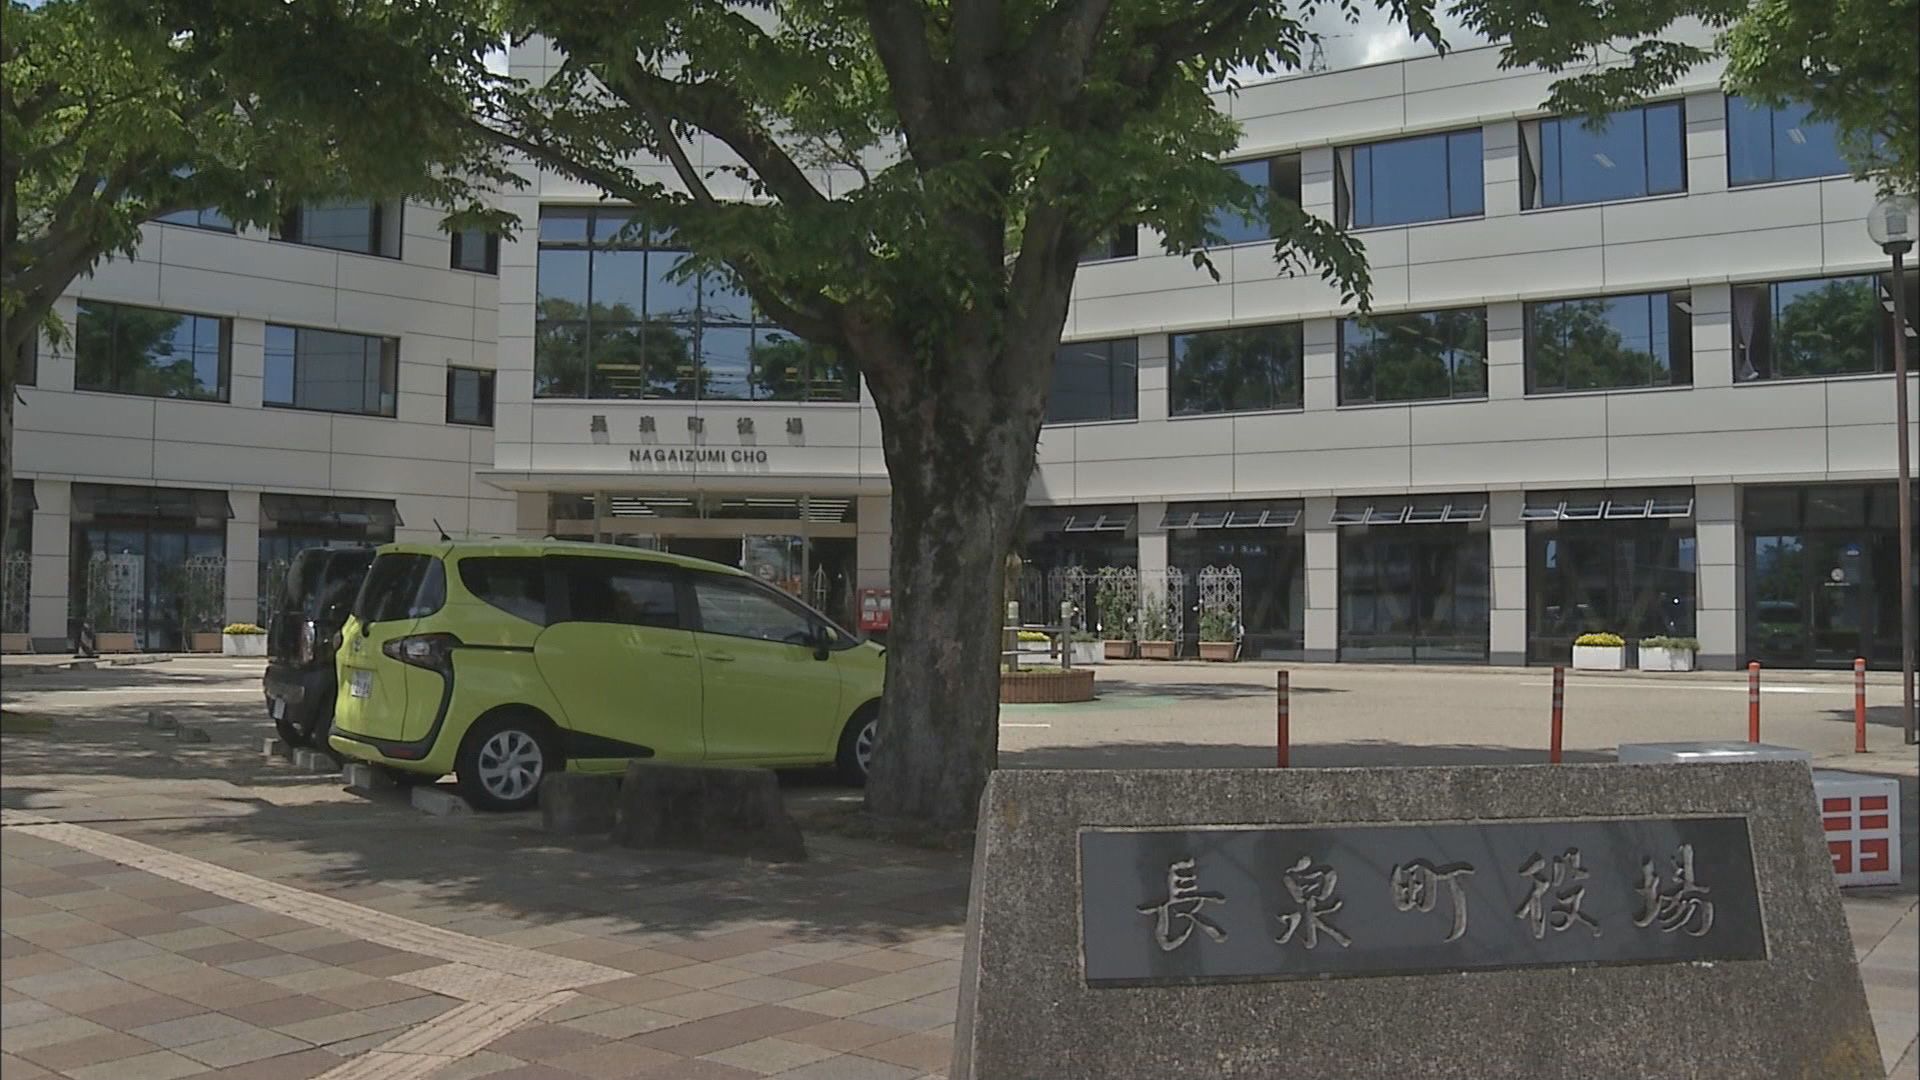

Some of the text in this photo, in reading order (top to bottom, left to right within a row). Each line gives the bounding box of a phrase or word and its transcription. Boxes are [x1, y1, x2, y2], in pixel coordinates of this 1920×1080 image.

[629, 449, 768, 463] NAGAIZUMI CHO
[1138, 845, 1714, 950] 長泉町役場
